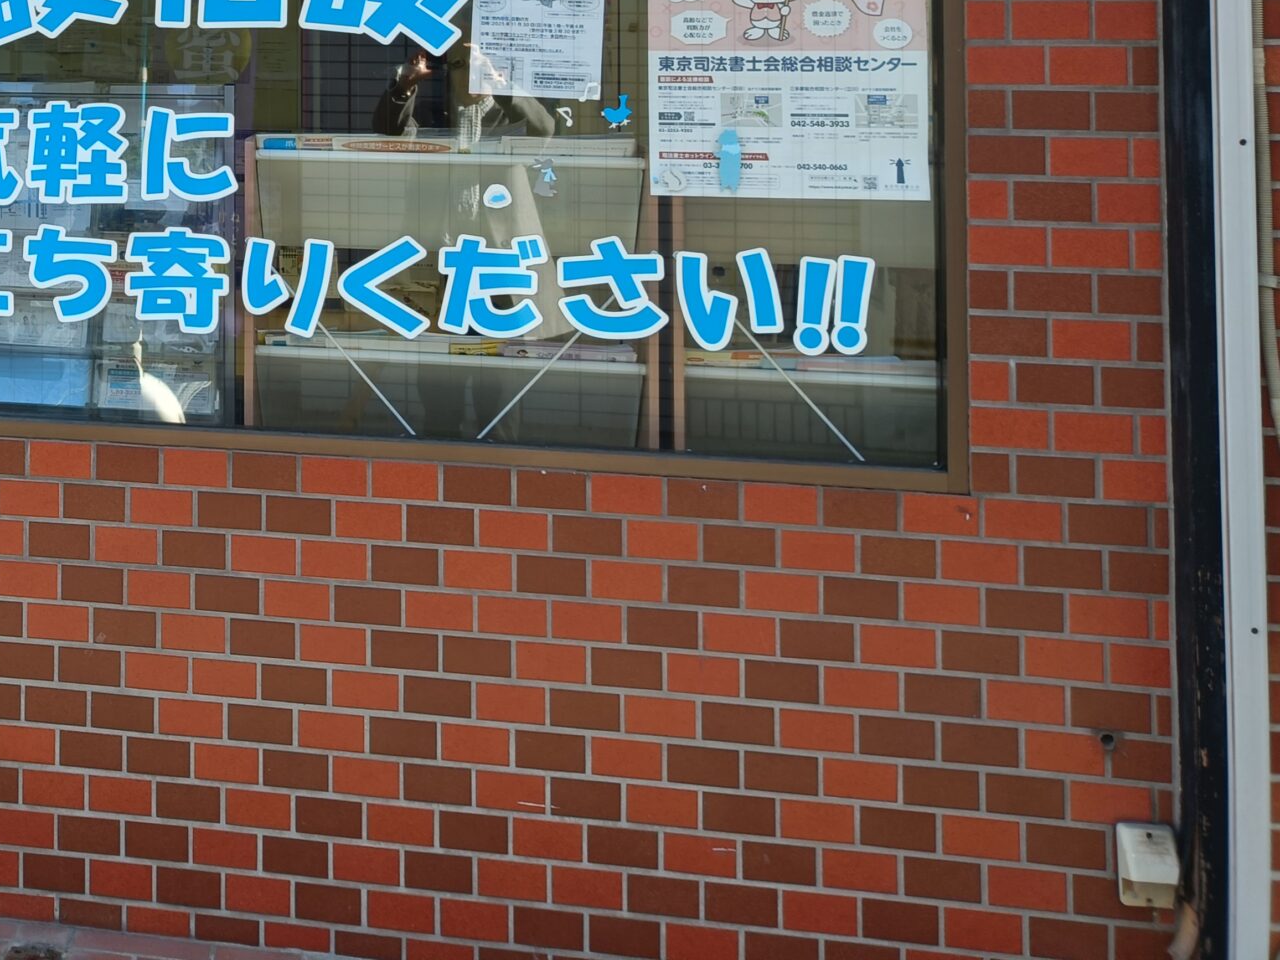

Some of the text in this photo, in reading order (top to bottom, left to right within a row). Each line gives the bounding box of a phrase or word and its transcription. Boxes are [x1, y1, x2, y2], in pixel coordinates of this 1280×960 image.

[658, 56, 918, 73] 東京司法書士会総合相談センター
[790, 120, 850, 128] 042-548-3933
